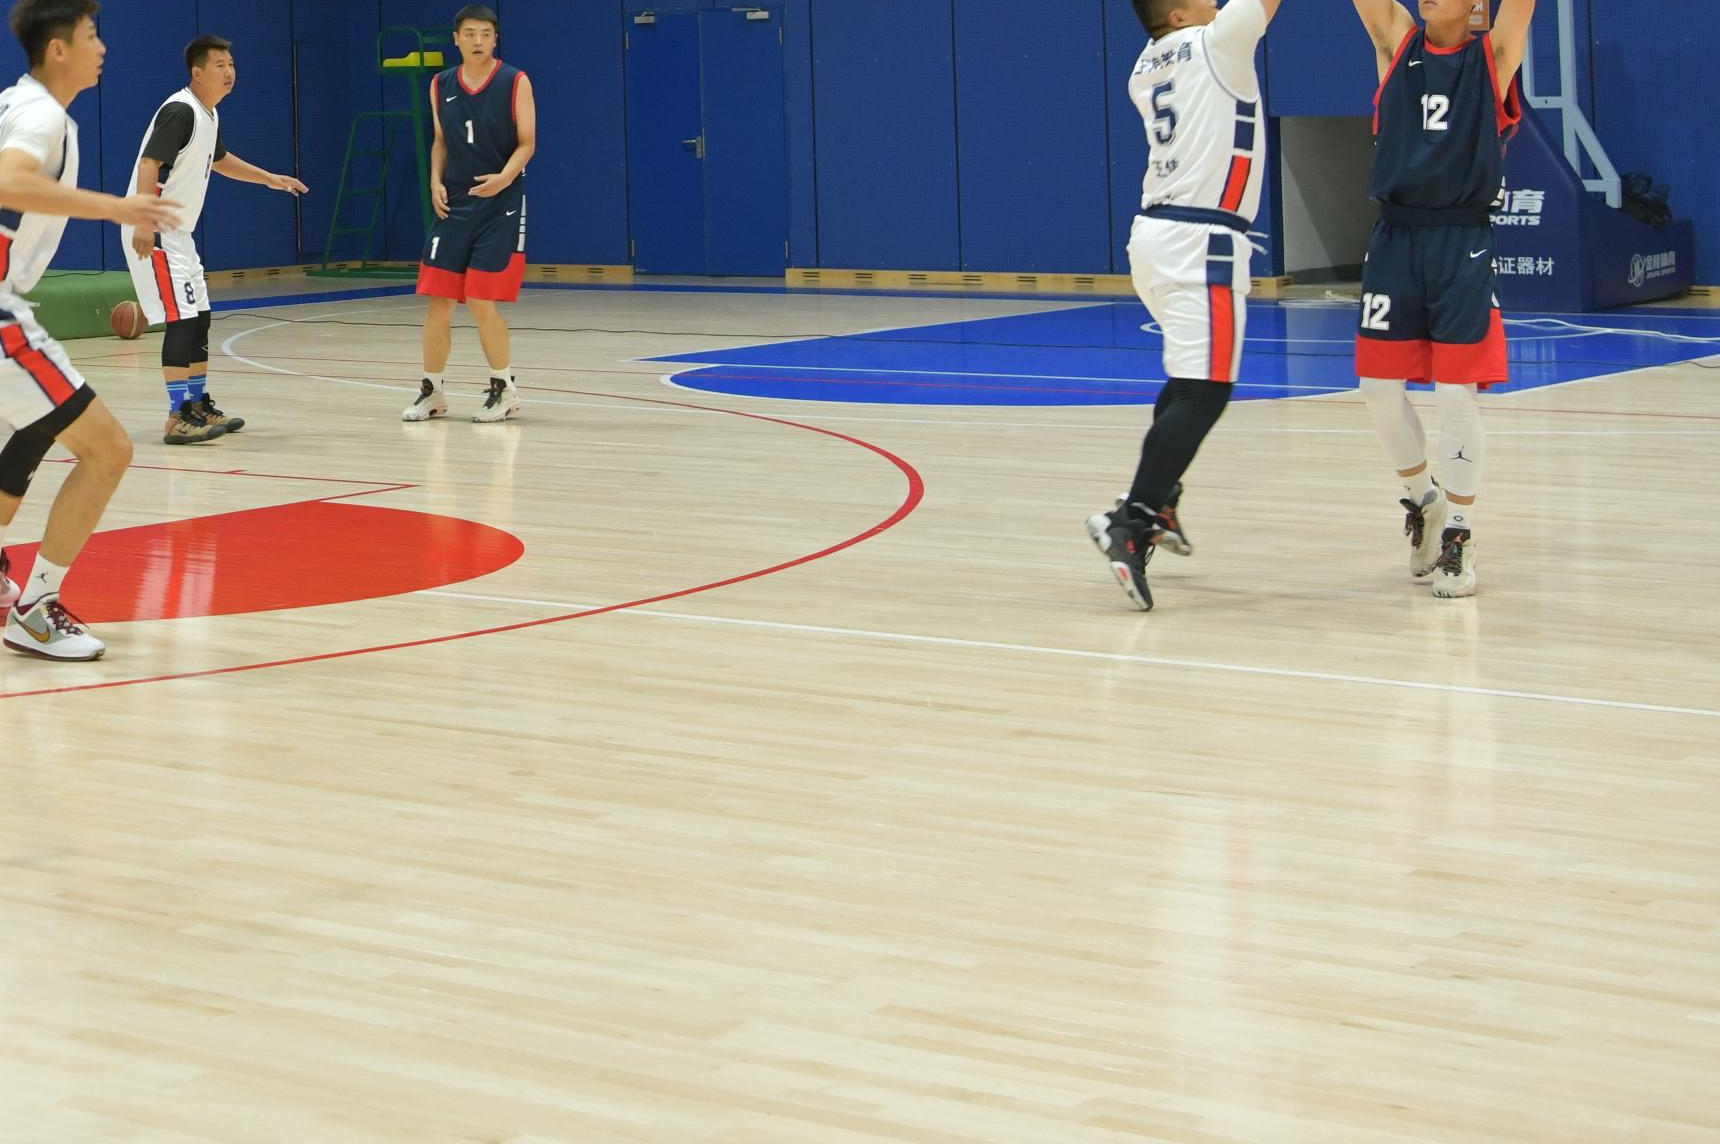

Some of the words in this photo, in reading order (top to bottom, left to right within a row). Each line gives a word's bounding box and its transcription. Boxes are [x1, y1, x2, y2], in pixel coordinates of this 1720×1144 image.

[1151, 80, 1177, 145] 5
[1420, 94, 1449, 131] 12
[464, 119, 475, 144] 1
[430, 236, 441, 260] 1
[1498, 255, 1554, 276] 证器材
[184, 281, 196, 305] 8
[1361, 293, 1391, 331] 12
